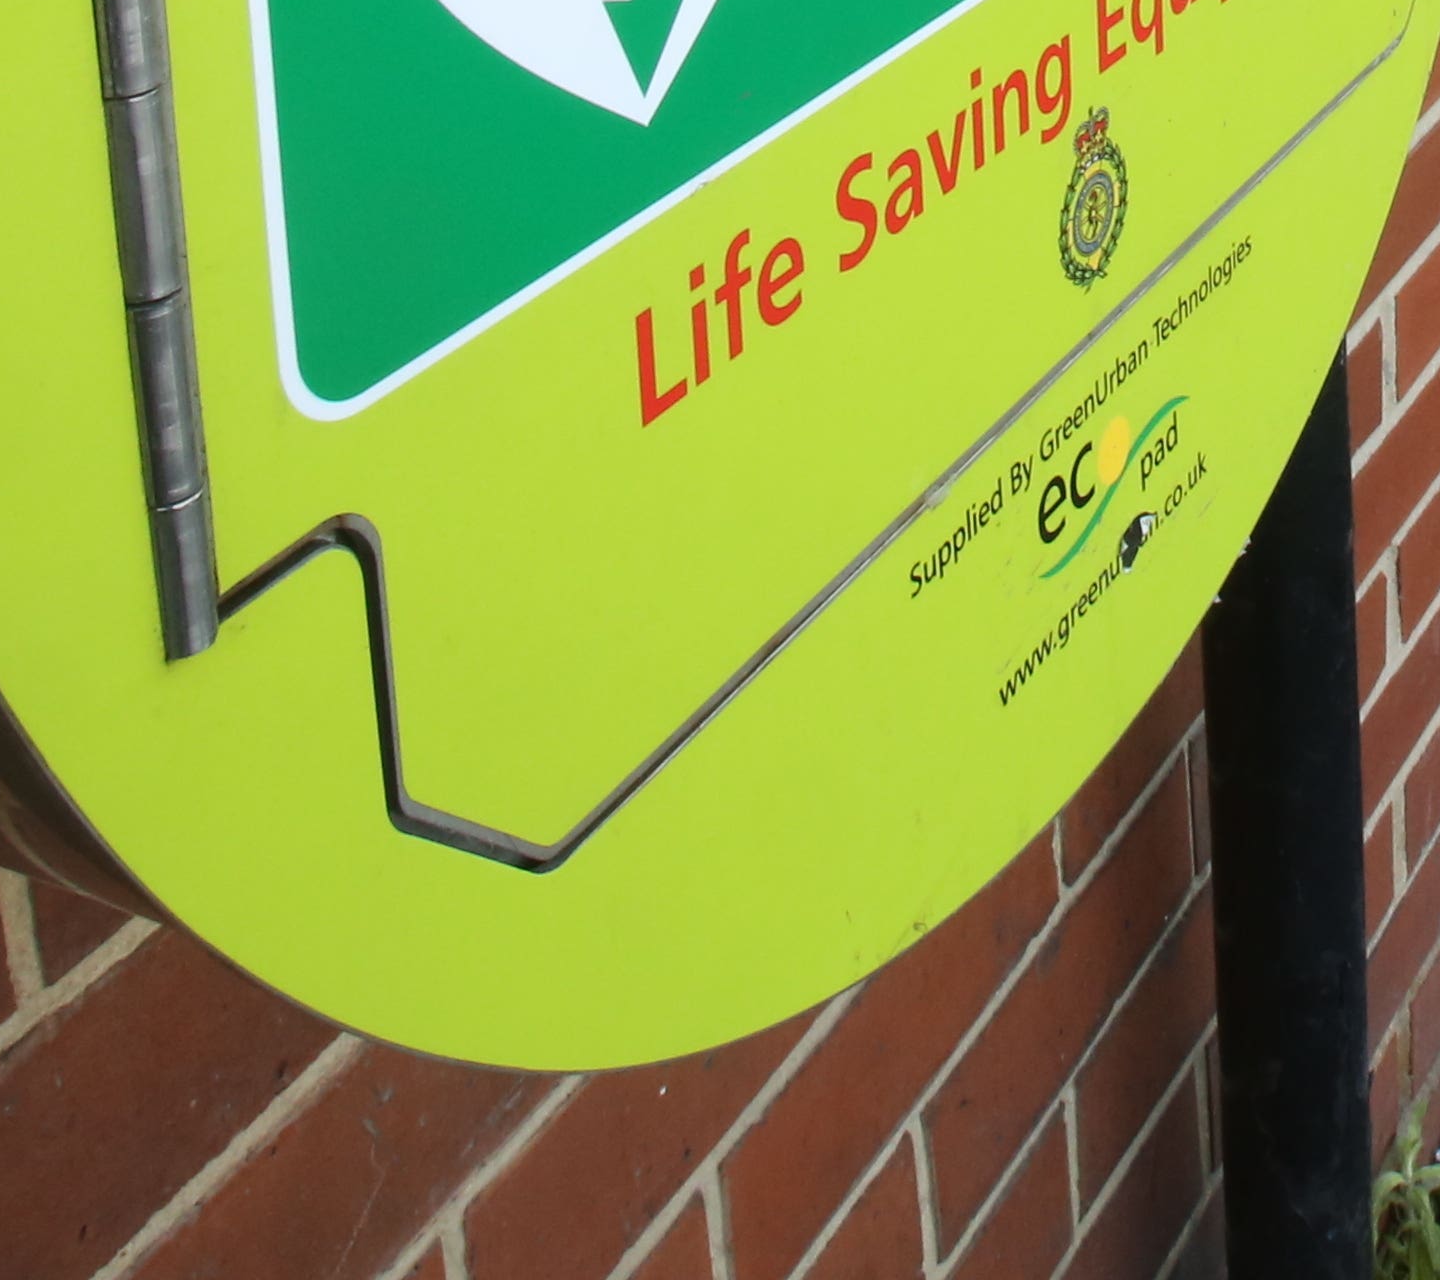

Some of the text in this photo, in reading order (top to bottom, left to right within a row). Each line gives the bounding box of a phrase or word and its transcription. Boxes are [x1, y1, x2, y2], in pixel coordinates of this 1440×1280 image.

[634, 228, 806, 428] Life
[834, 35, 1071, 272] Saving
[909, 235, 1253, 598] Supplied By GreenUrban Technologies
[1140, 411, 1180, 492] pad
[999, 450, 1209, 707] www.greenun.co.uk
